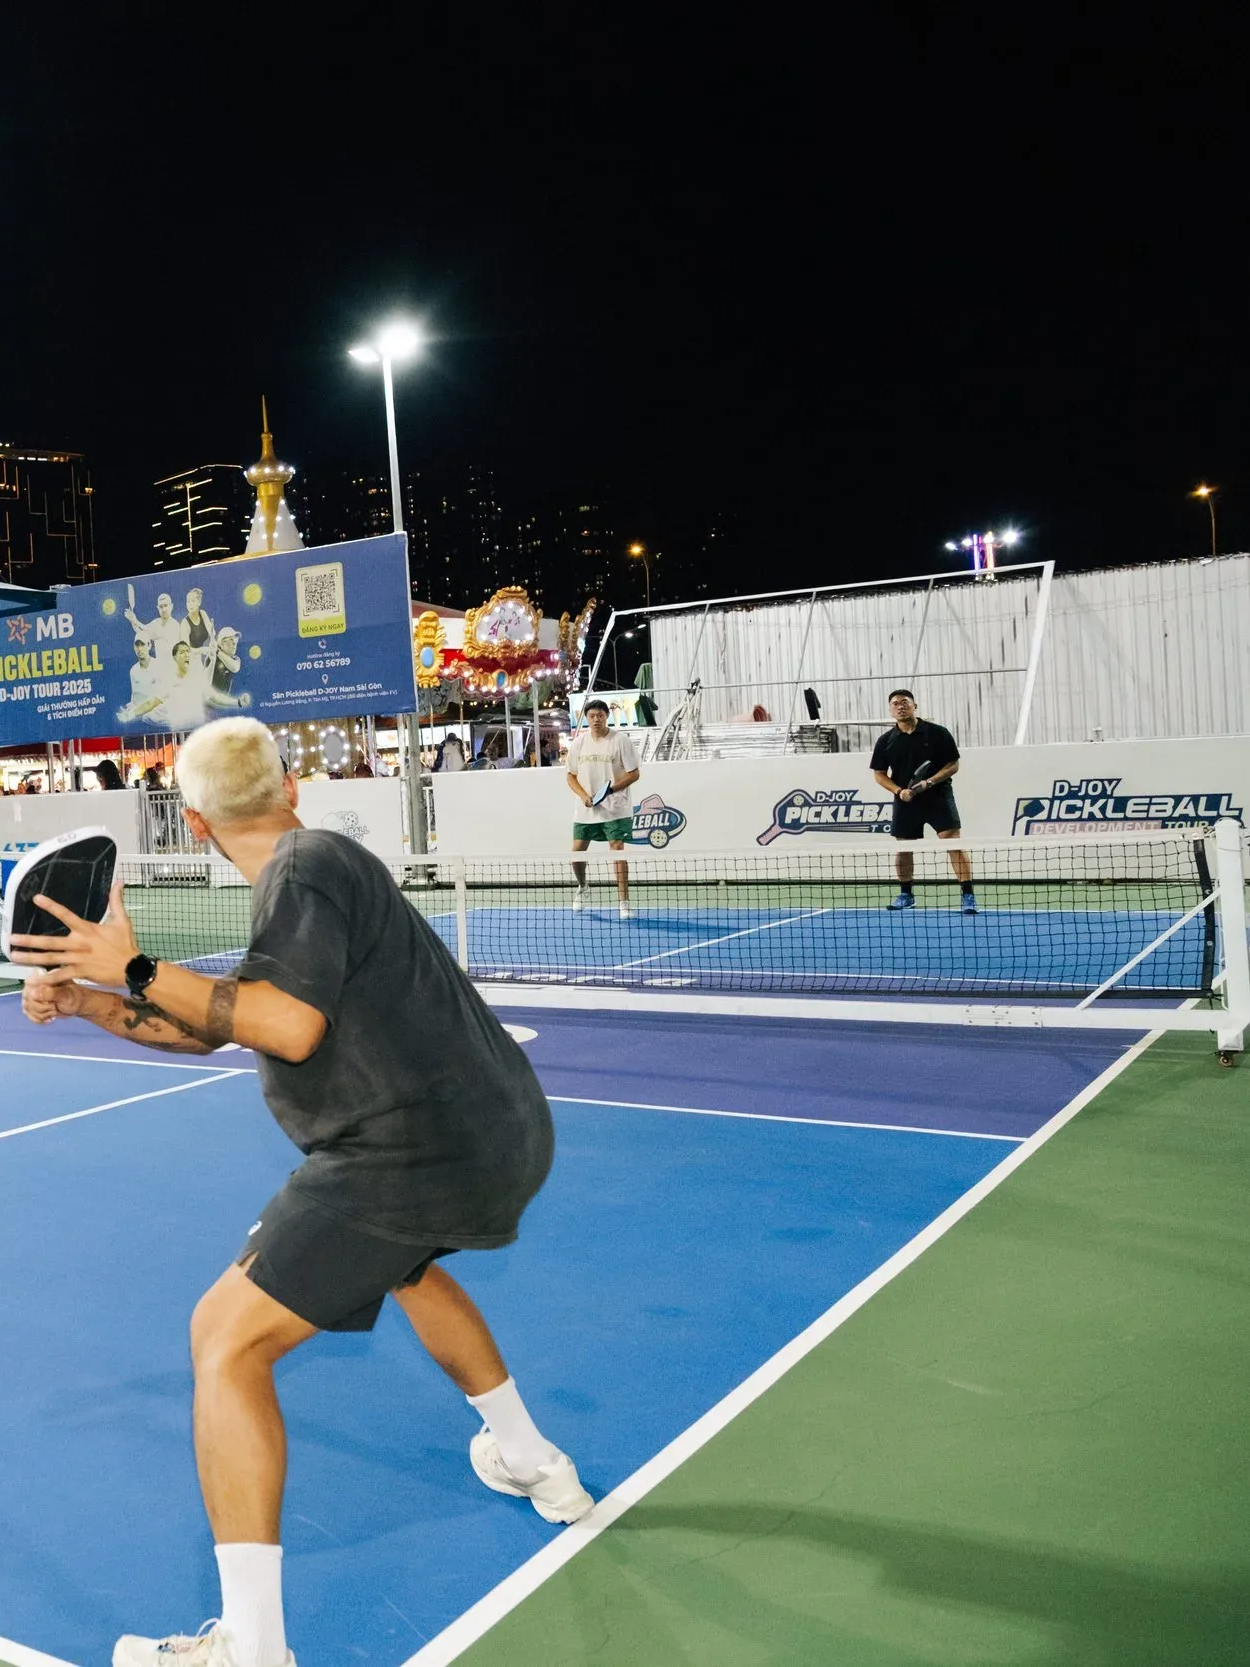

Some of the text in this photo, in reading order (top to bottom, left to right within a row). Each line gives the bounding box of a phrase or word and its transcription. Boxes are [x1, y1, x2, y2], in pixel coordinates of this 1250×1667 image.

[36, 613, 75, 642] MB
[296, 657, 351, 670] 070 62 56789
[32, 682, 61, 699] TOUR
[62, 678, 92, 696] 2025
[285, 688, 317, 698] Pickleball
[317, 686, 339, 695] D-JOY
[339, 685, 356, 693] Nam
[816, 791, 854, 802] D-JOY
[1053, 780, 1119, 797] D-JOY
[632, 812, 670, 830] LEBALL
[785, 804, 893, 824] PICKLEBA
[871, 825, 891, 833] TO
[1032, 821, 1161, 836] DEVELOPMENT
